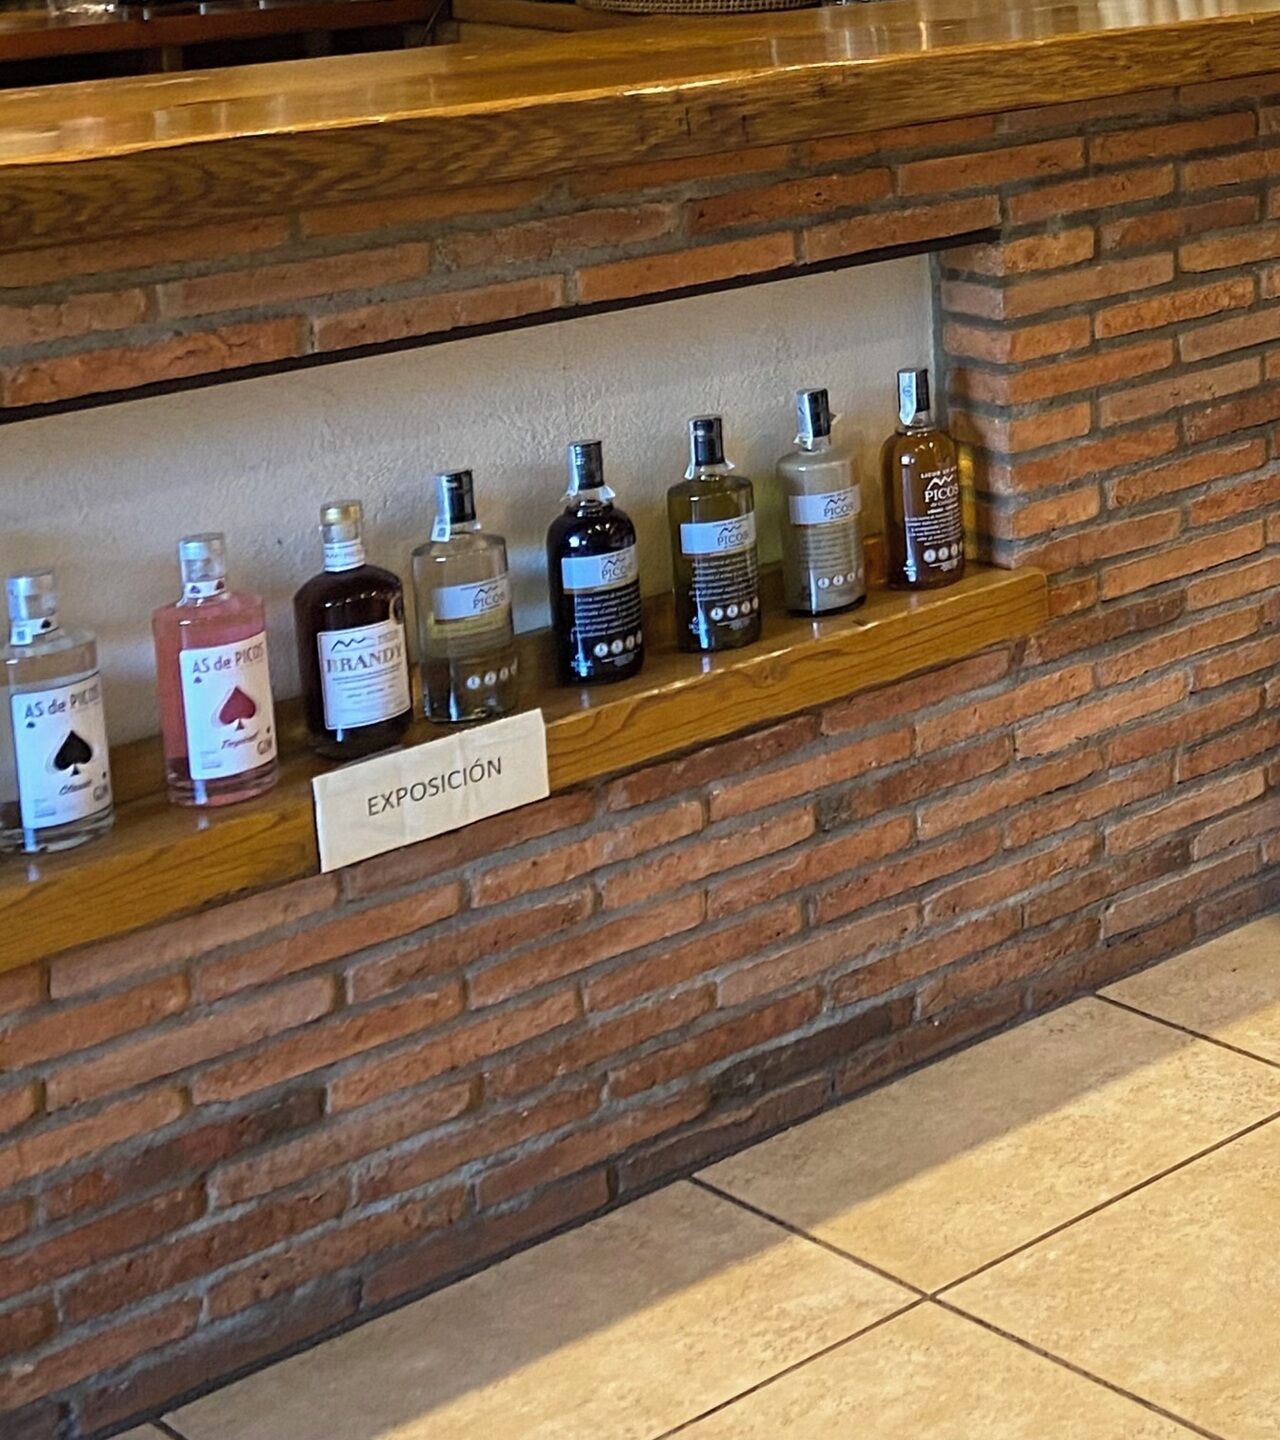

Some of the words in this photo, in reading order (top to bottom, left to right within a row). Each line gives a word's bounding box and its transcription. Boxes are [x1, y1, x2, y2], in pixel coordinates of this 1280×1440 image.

[925, 483, 958, 502] PICOS
[823, 501, 855, 519] PICOS
[716, 529, 749, 547] PICOS
[192, 657, 210, 673] AS
[213, 656, 232, 670] de
[235, 642, 264, 666] PICOS
[326, 643, 401, 673] BRANDY
[366, 756, 503, 818] EXPOSICIÓN
